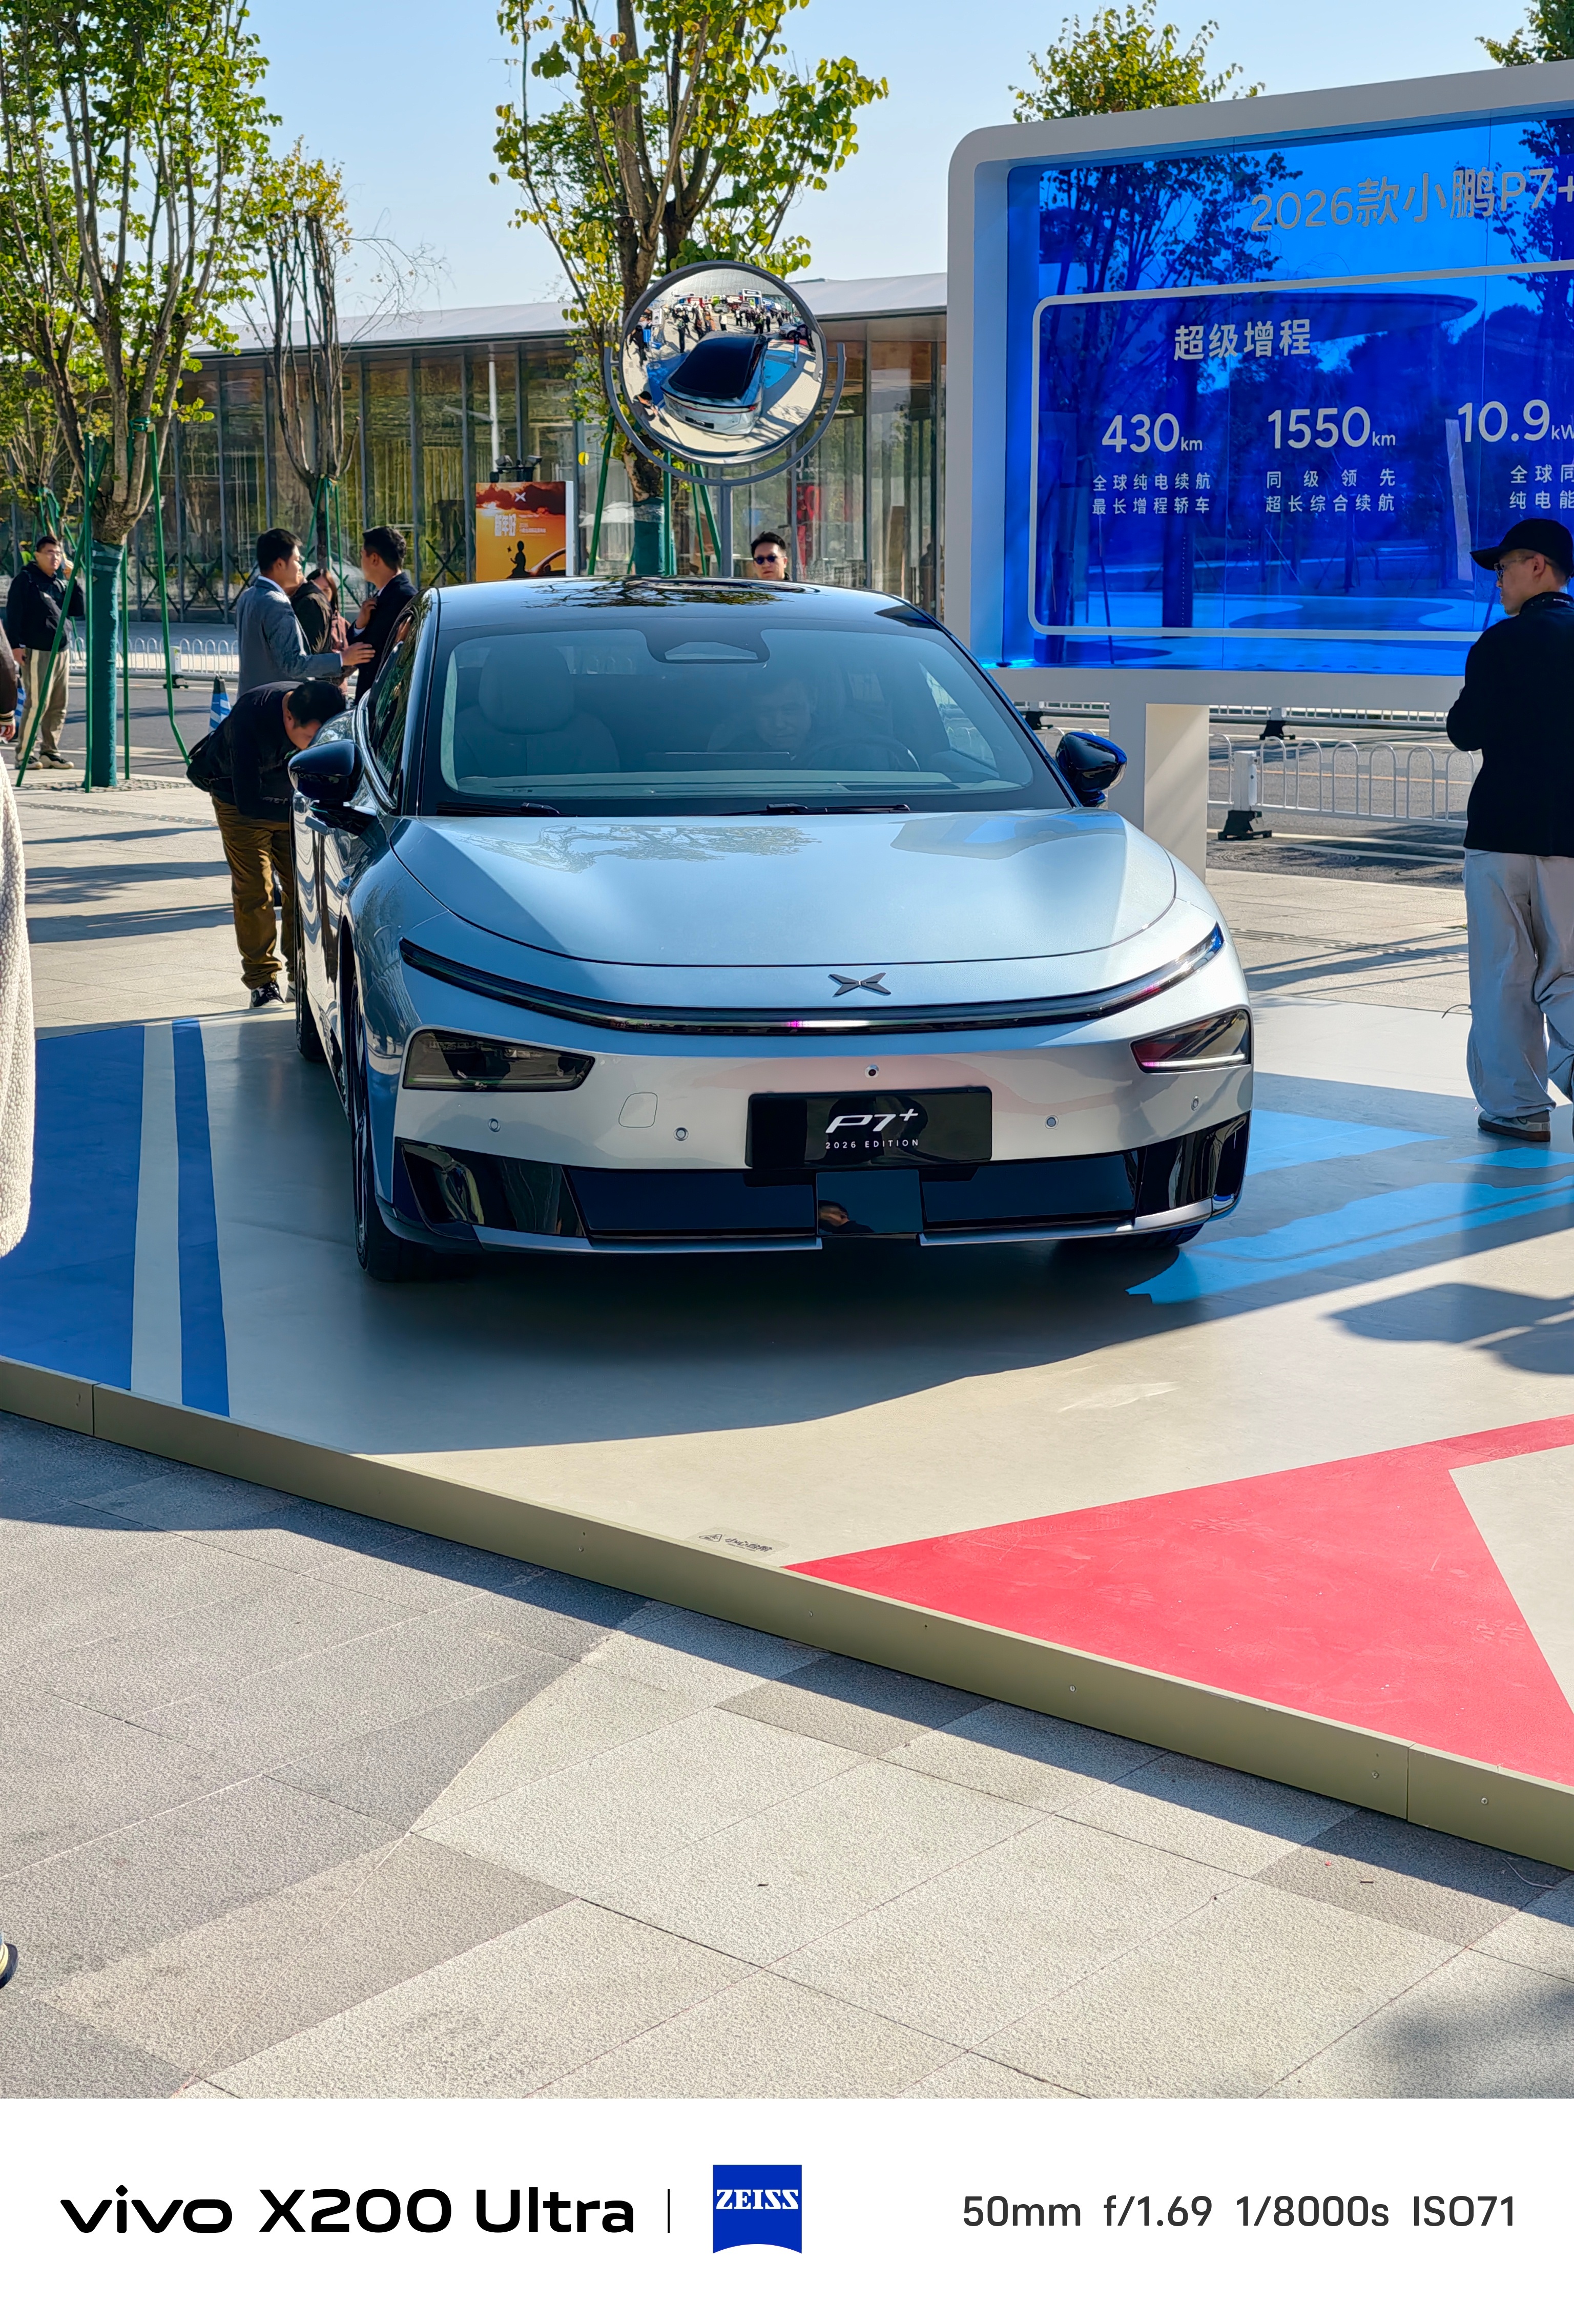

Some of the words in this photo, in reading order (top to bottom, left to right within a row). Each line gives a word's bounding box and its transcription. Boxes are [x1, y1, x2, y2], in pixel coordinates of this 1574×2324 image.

[1251, 167, 1574, 232] 2026款小鹏P7+
[1174, 319, 1311, 361] 超级增程
[1092, 472, 1211, 491] 全球纯电续航
[1266, 468, 1396, 489] 同级领先
[1510, 464, 1574, 484] 全球同
[1092, 496, 1210, 515] 最长增程轿车
[1266, 493, 1395, 513] 超长综合续航
[825, 1108, 919, 1134] P7+
[825, 1141, 857, 1150] 2026
[864, 1138, 919, 1148] EDITION
